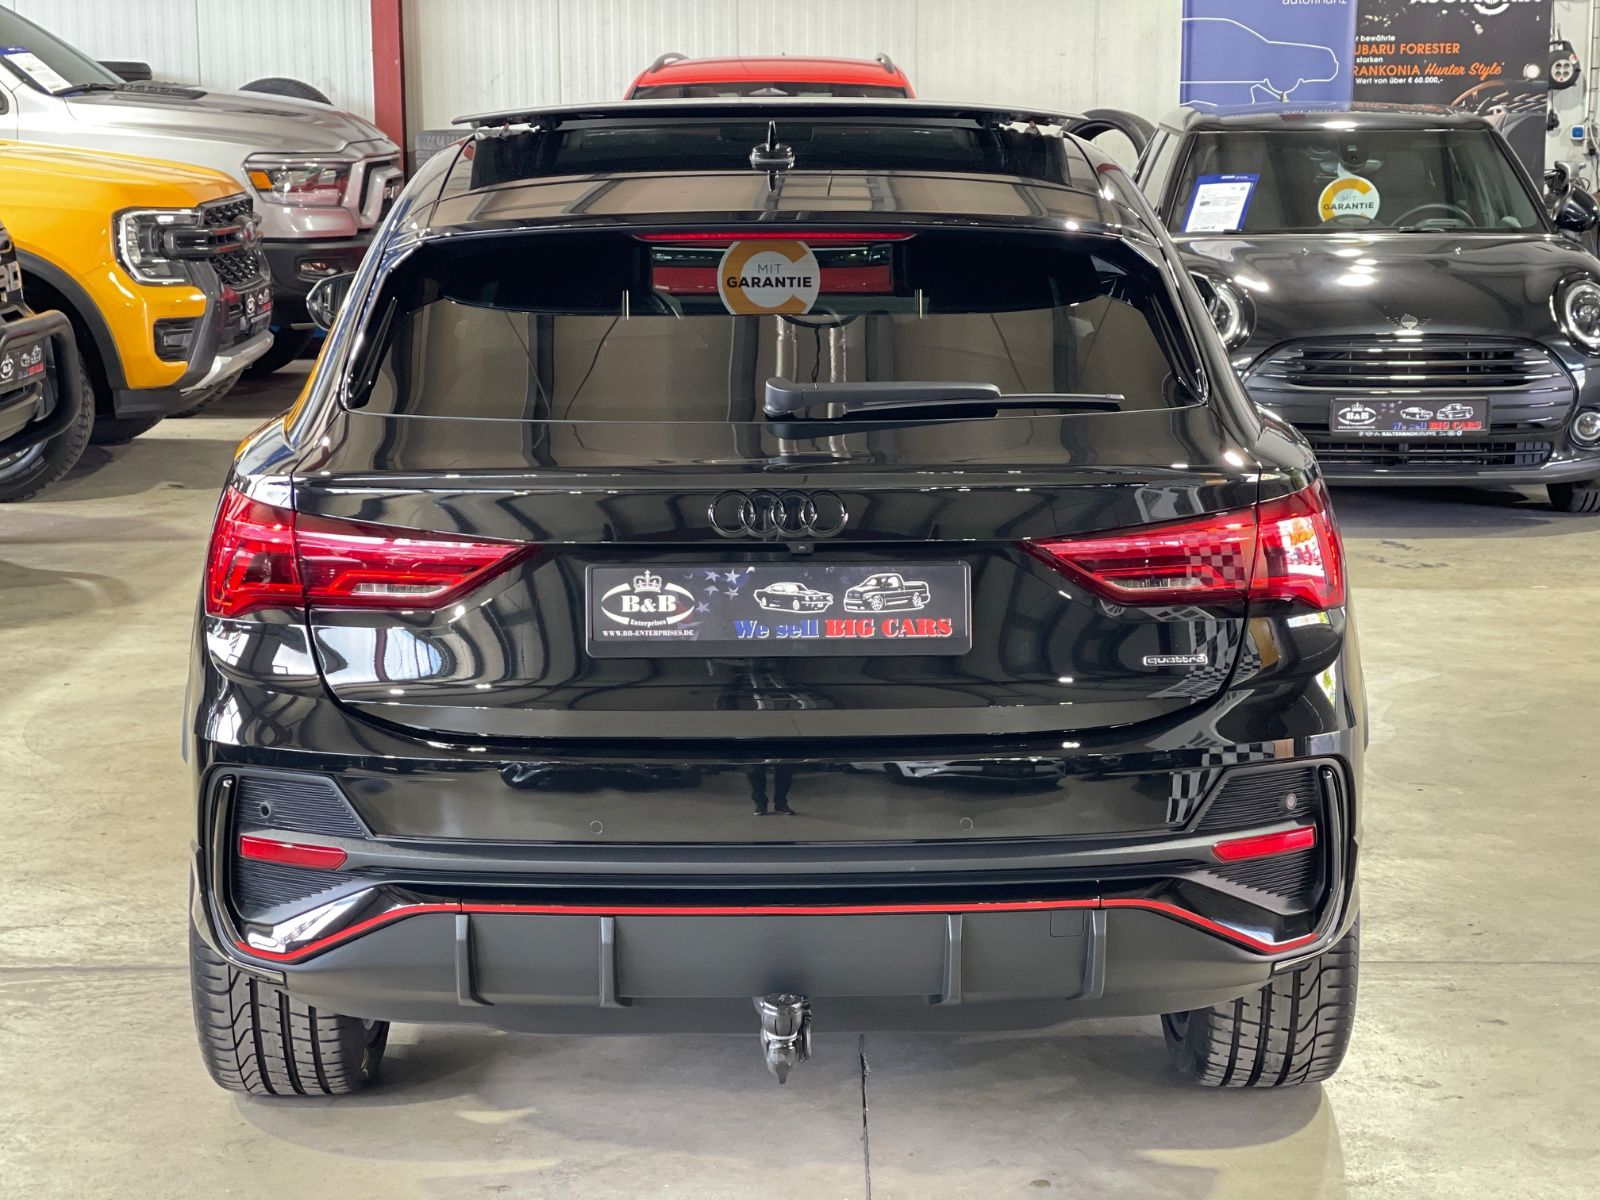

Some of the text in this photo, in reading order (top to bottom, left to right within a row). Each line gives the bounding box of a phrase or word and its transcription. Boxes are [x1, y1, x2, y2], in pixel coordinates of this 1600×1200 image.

[1354, 42, 1460, 55] UBARU FORESTER
[1353, 64, 1420, 76] RANKONIA
[1389, 76, 1406, 84] über
[1323, 202, 1374, 211] GARANTIE
[757, 263, 782, 274] MIT
[726, 276, 812, 288] GARANTIE
[620, 594, 677, 613] B&B
[630, 618, 667, 627] Enterprises
[735, 618, 953, 639] We sell BIG CARS
[1147, 656, 1205, 664] quattro
